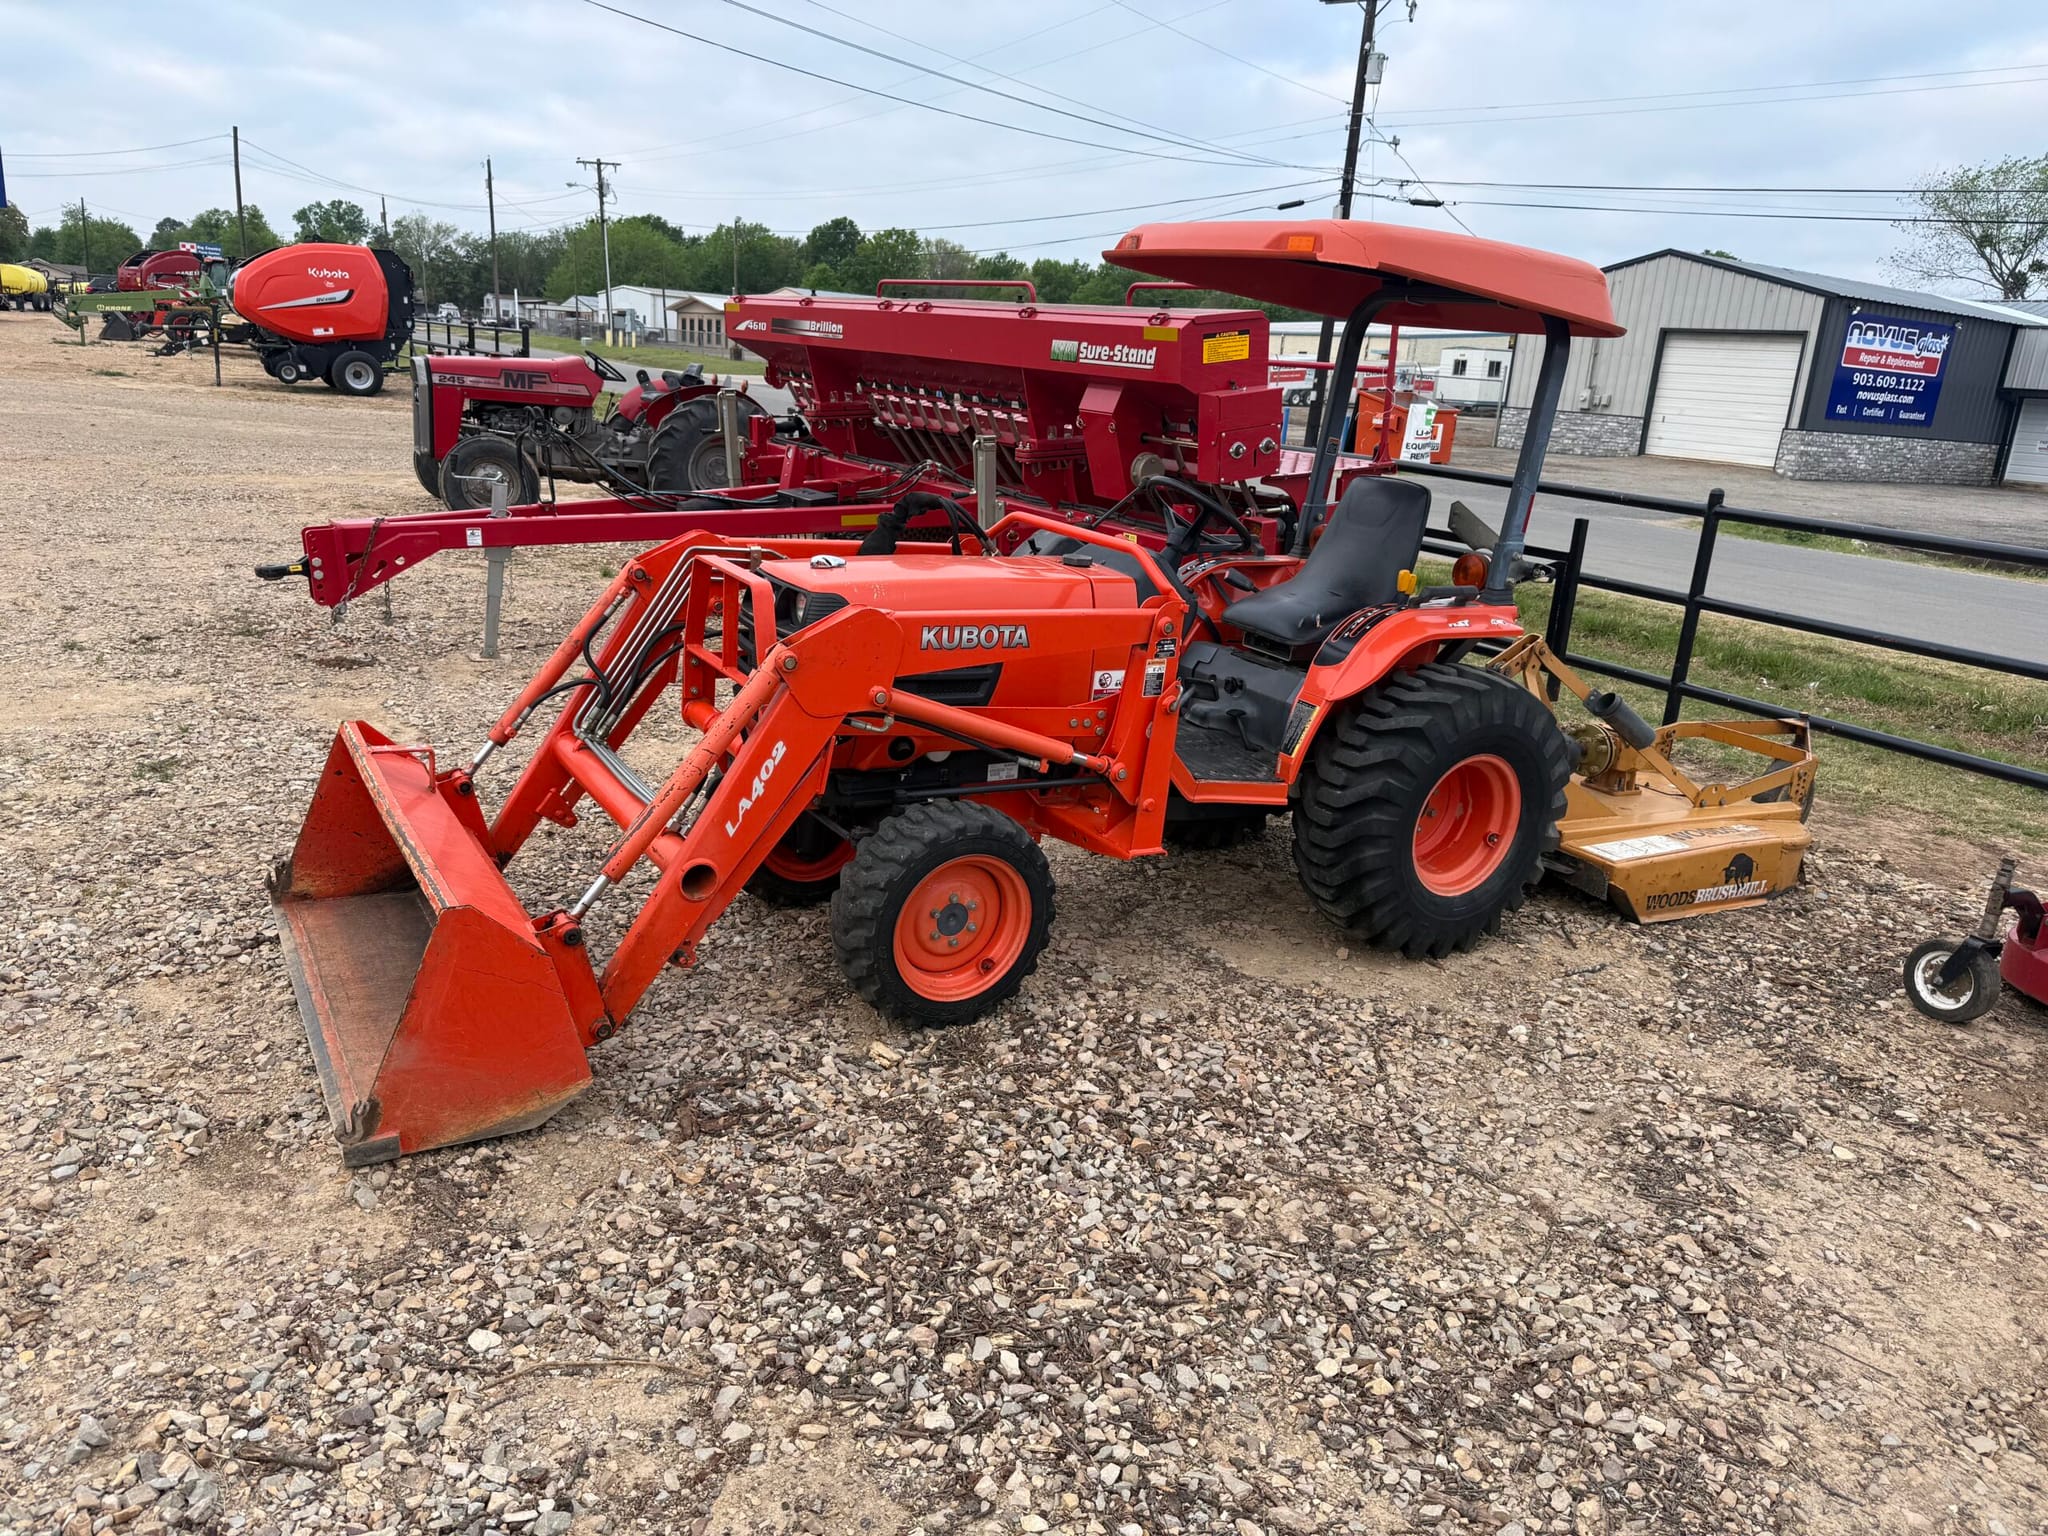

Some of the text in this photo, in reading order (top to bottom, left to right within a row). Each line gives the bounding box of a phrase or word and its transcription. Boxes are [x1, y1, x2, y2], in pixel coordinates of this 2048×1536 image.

[308, 268, 350, 279] Kubota
[810, 321, 843, 333] Brillion
[1917, 332, 1944, 356] glass
[1859, 352, 1925, 369] Repair & Replacement
[438, 375, 465, 384] 245
[504, 372, 547, 389] MF
[1852, 372, 1925, 391] 903.609.1122
[1856, 390, 1915, 404] novusglass.com
[1836, 404, 1926, 420] Fast Certified Guaranteed
[920, 624, 1030, 651] KUBOTA
[725, 740, 787, 838] LA402
